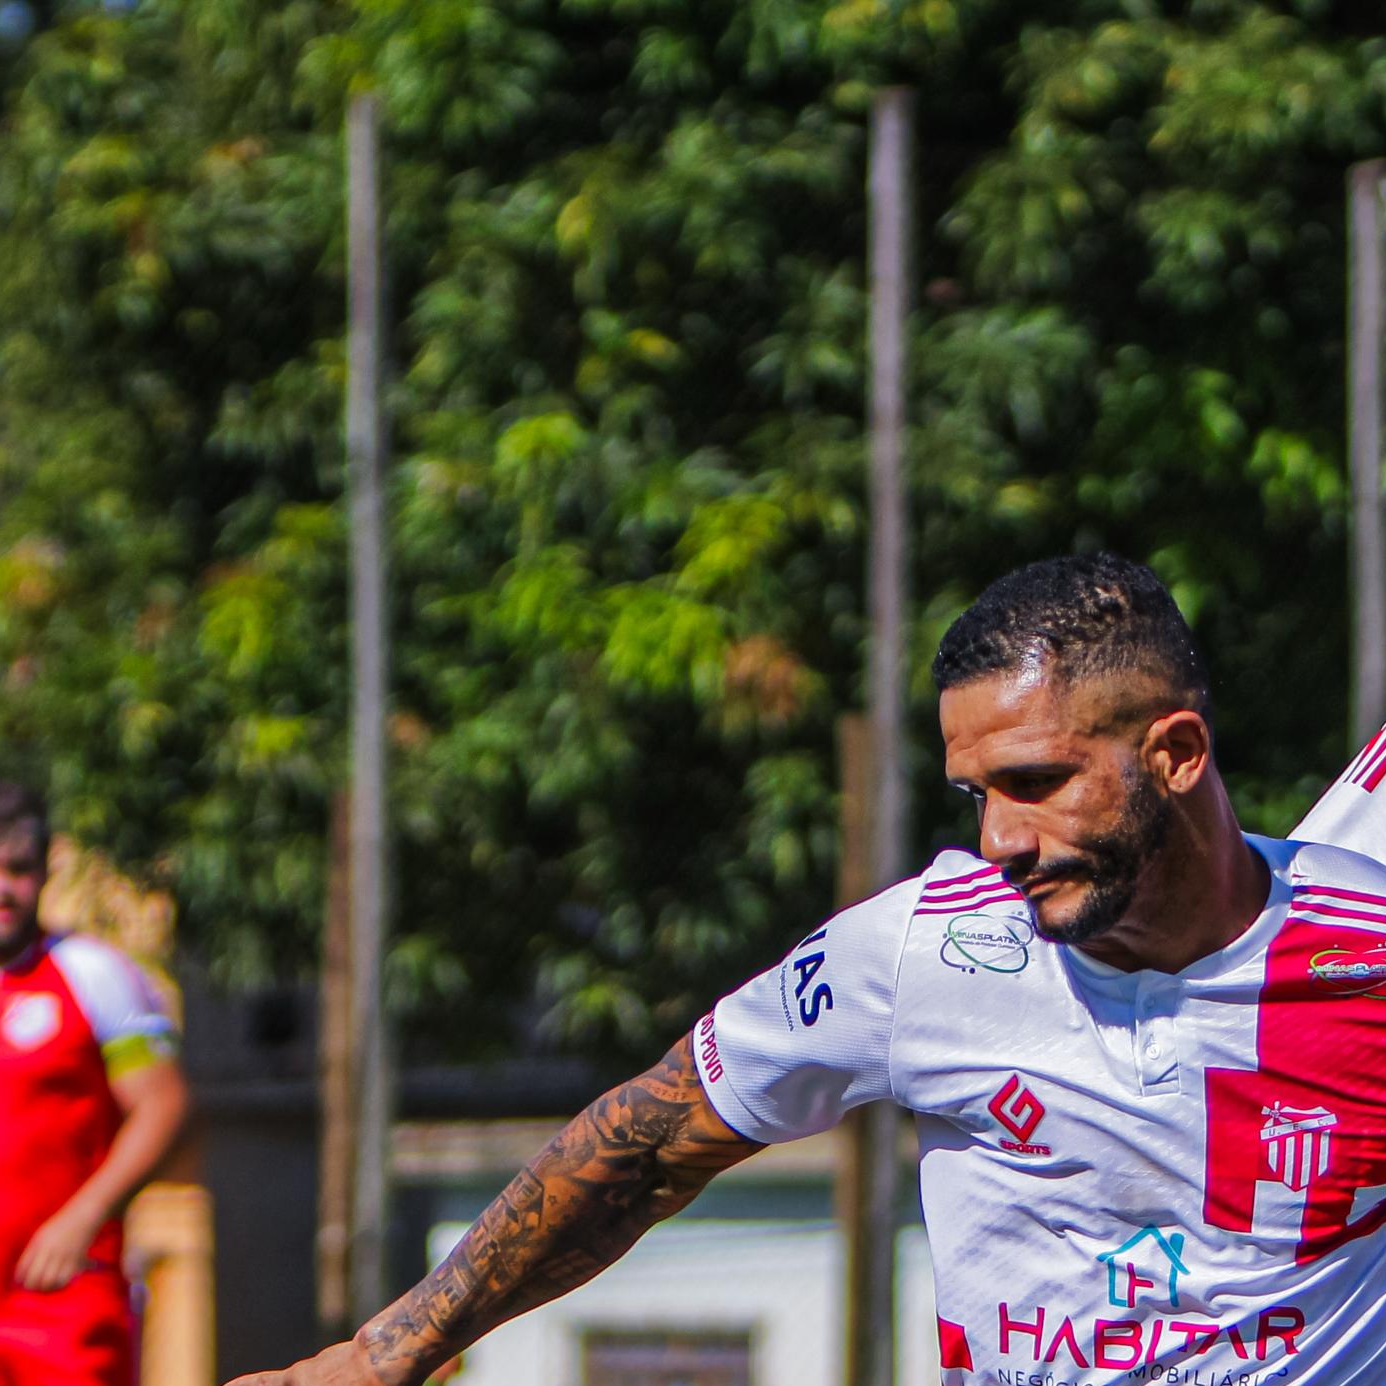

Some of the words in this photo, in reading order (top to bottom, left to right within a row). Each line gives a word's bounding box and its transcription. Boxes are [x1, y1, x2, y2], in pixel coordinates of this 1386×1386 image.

[701, 1033, 724, 1084] POVO
[1000, 1139, 1051, 1155] SPORTS
[997, 1302, 1305, 1370] HABITAR
